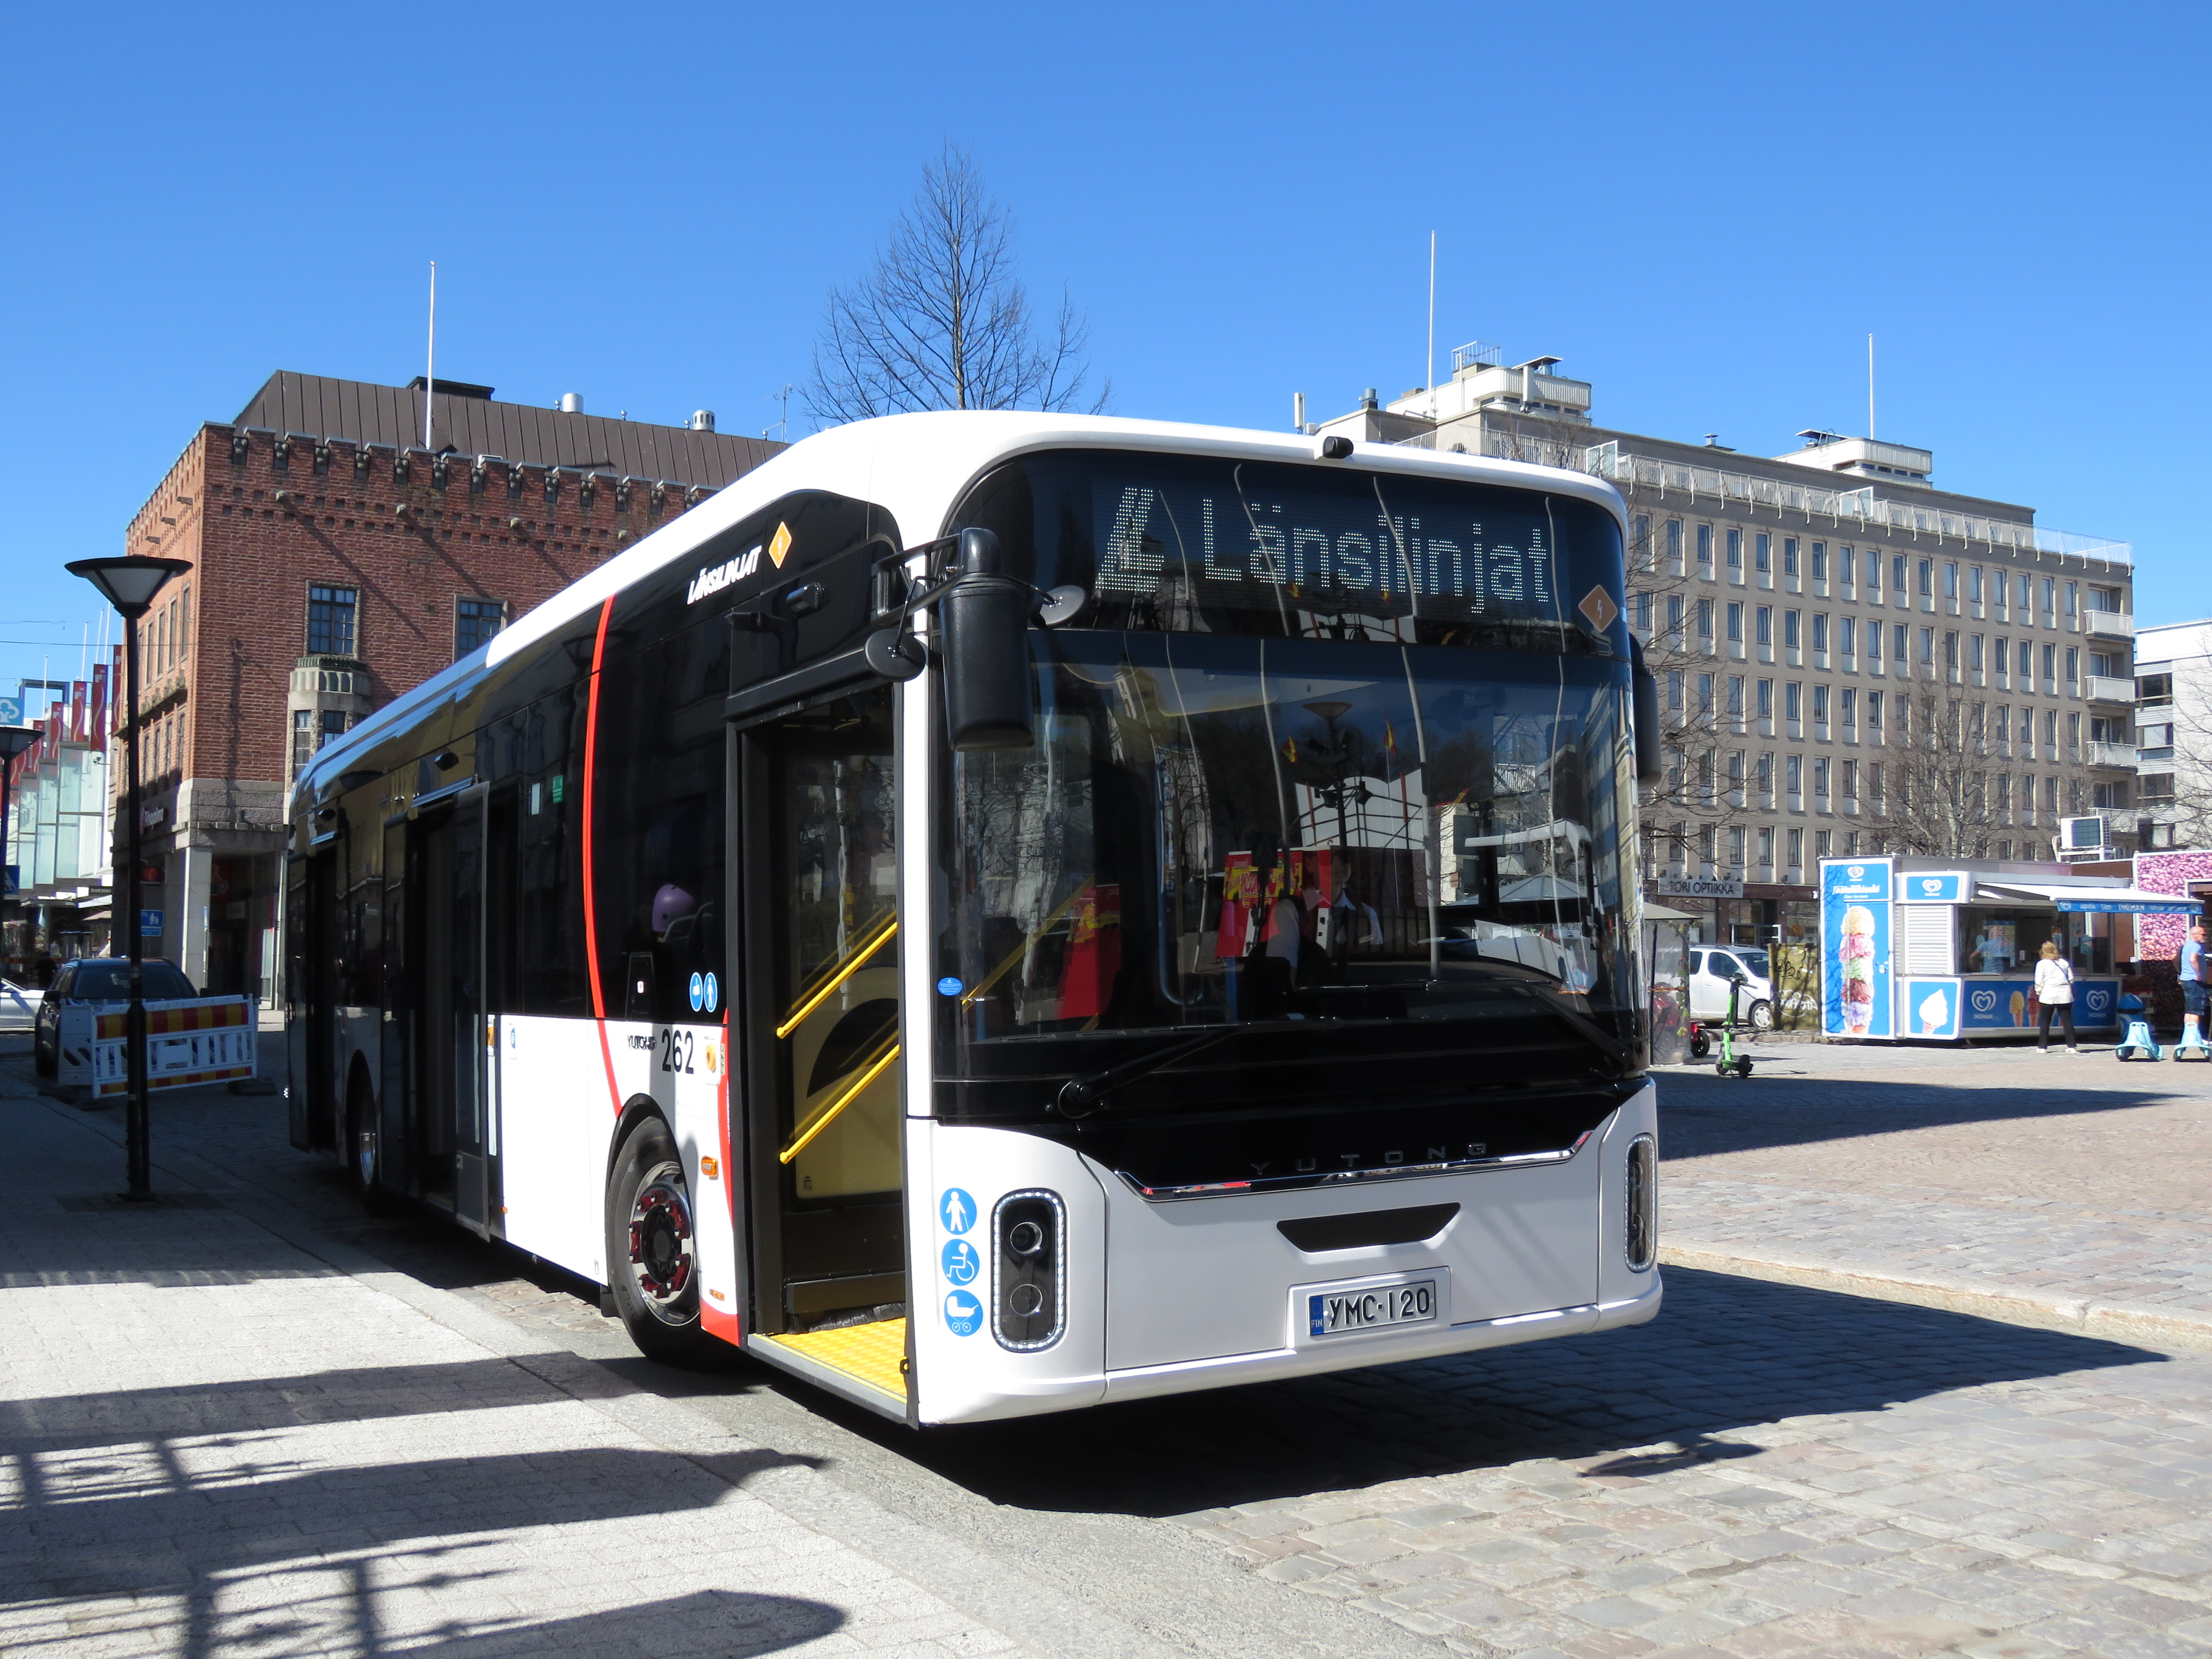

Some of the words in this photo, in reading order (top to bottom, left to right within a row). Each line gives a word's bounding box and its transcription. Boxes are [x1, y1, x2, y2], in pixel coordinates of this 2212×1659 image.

[1202, 498, 1549, 614] Länsilinjat
[1669, 881, 1691, 893] TORI
[1693, 882, 1734, 895] OPTIIKKA
[661, 1029, 694, 1074] 262
[1250, 1142, 1487, 1175] YUTONG
[1311, 1319, 1323, 1328] FIN
[1328, 1287, 1430, 1327] YMC-120
